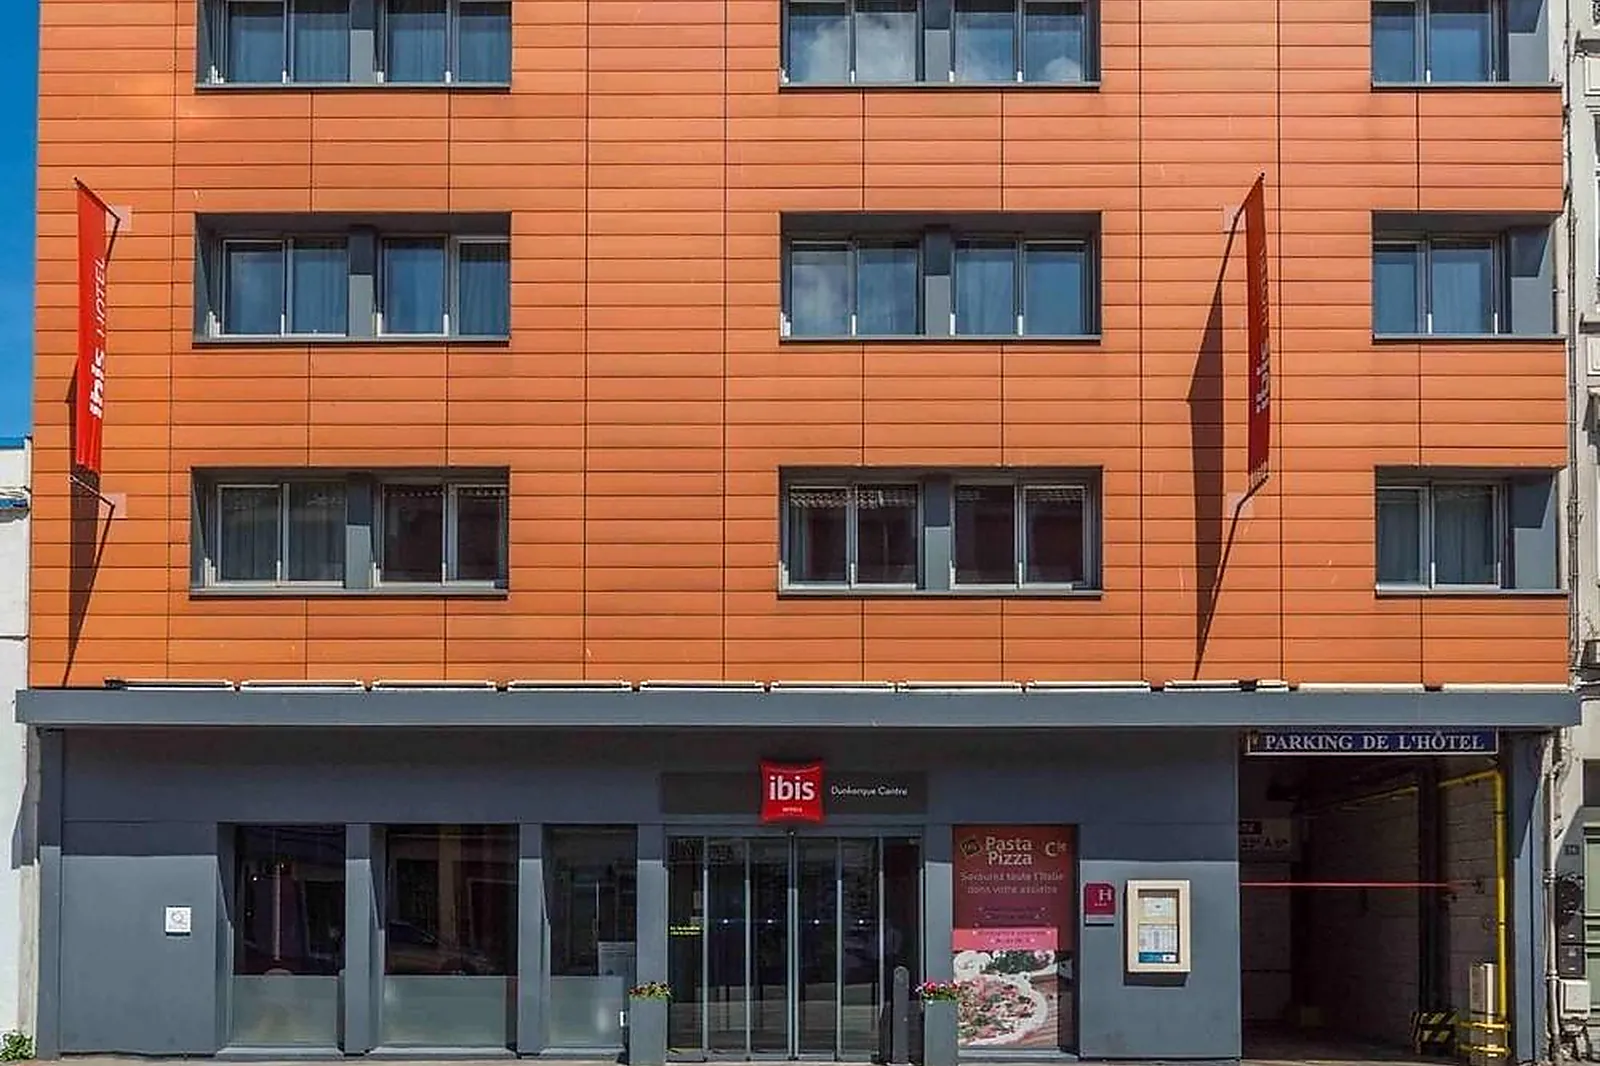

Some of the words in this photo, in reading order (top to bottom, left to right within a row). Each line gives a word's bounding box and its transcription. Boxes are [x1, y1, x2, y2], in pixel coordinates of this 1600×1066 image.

[89, 347, 105, 420] ibis
[1265, 734, 1353, 750] PARKING
[1363, 734, 1389, 750] DE
[1399, 730, 1485, 750] L'HÔTEL
[768, 775, 816, 801] ibis
[831, 785, 876, 799] Dunkerque
[877, 785, 908, 796] Centre
[985, 835, 1033, 852] Pasta
[988, 850, 1033, 866] Pizza
[1100, 889, 1112, 901] H
